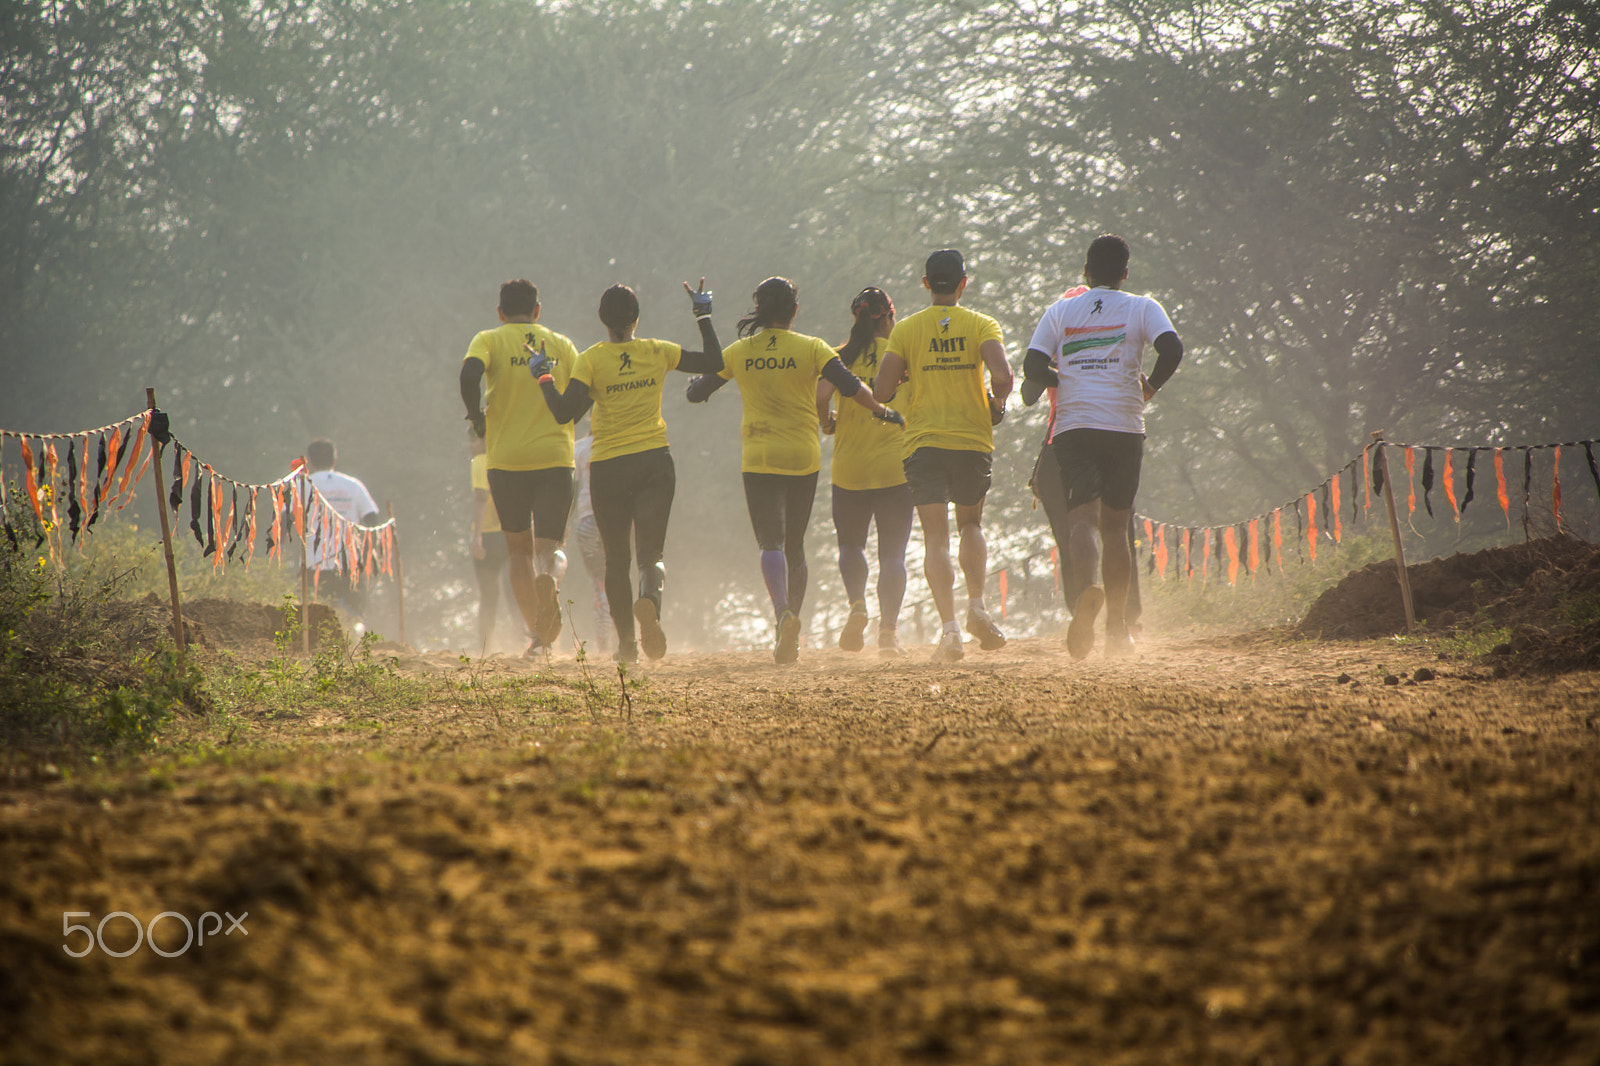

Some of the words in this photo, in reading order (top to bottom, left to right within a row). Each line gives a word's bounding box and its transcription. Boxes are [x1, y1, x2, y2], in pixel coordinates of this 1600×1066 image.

[928, 336, 967, 353] AMIT
[745, 357, 797, 372] POOJA
[606, 377, 657, 394] PRIYANKA
